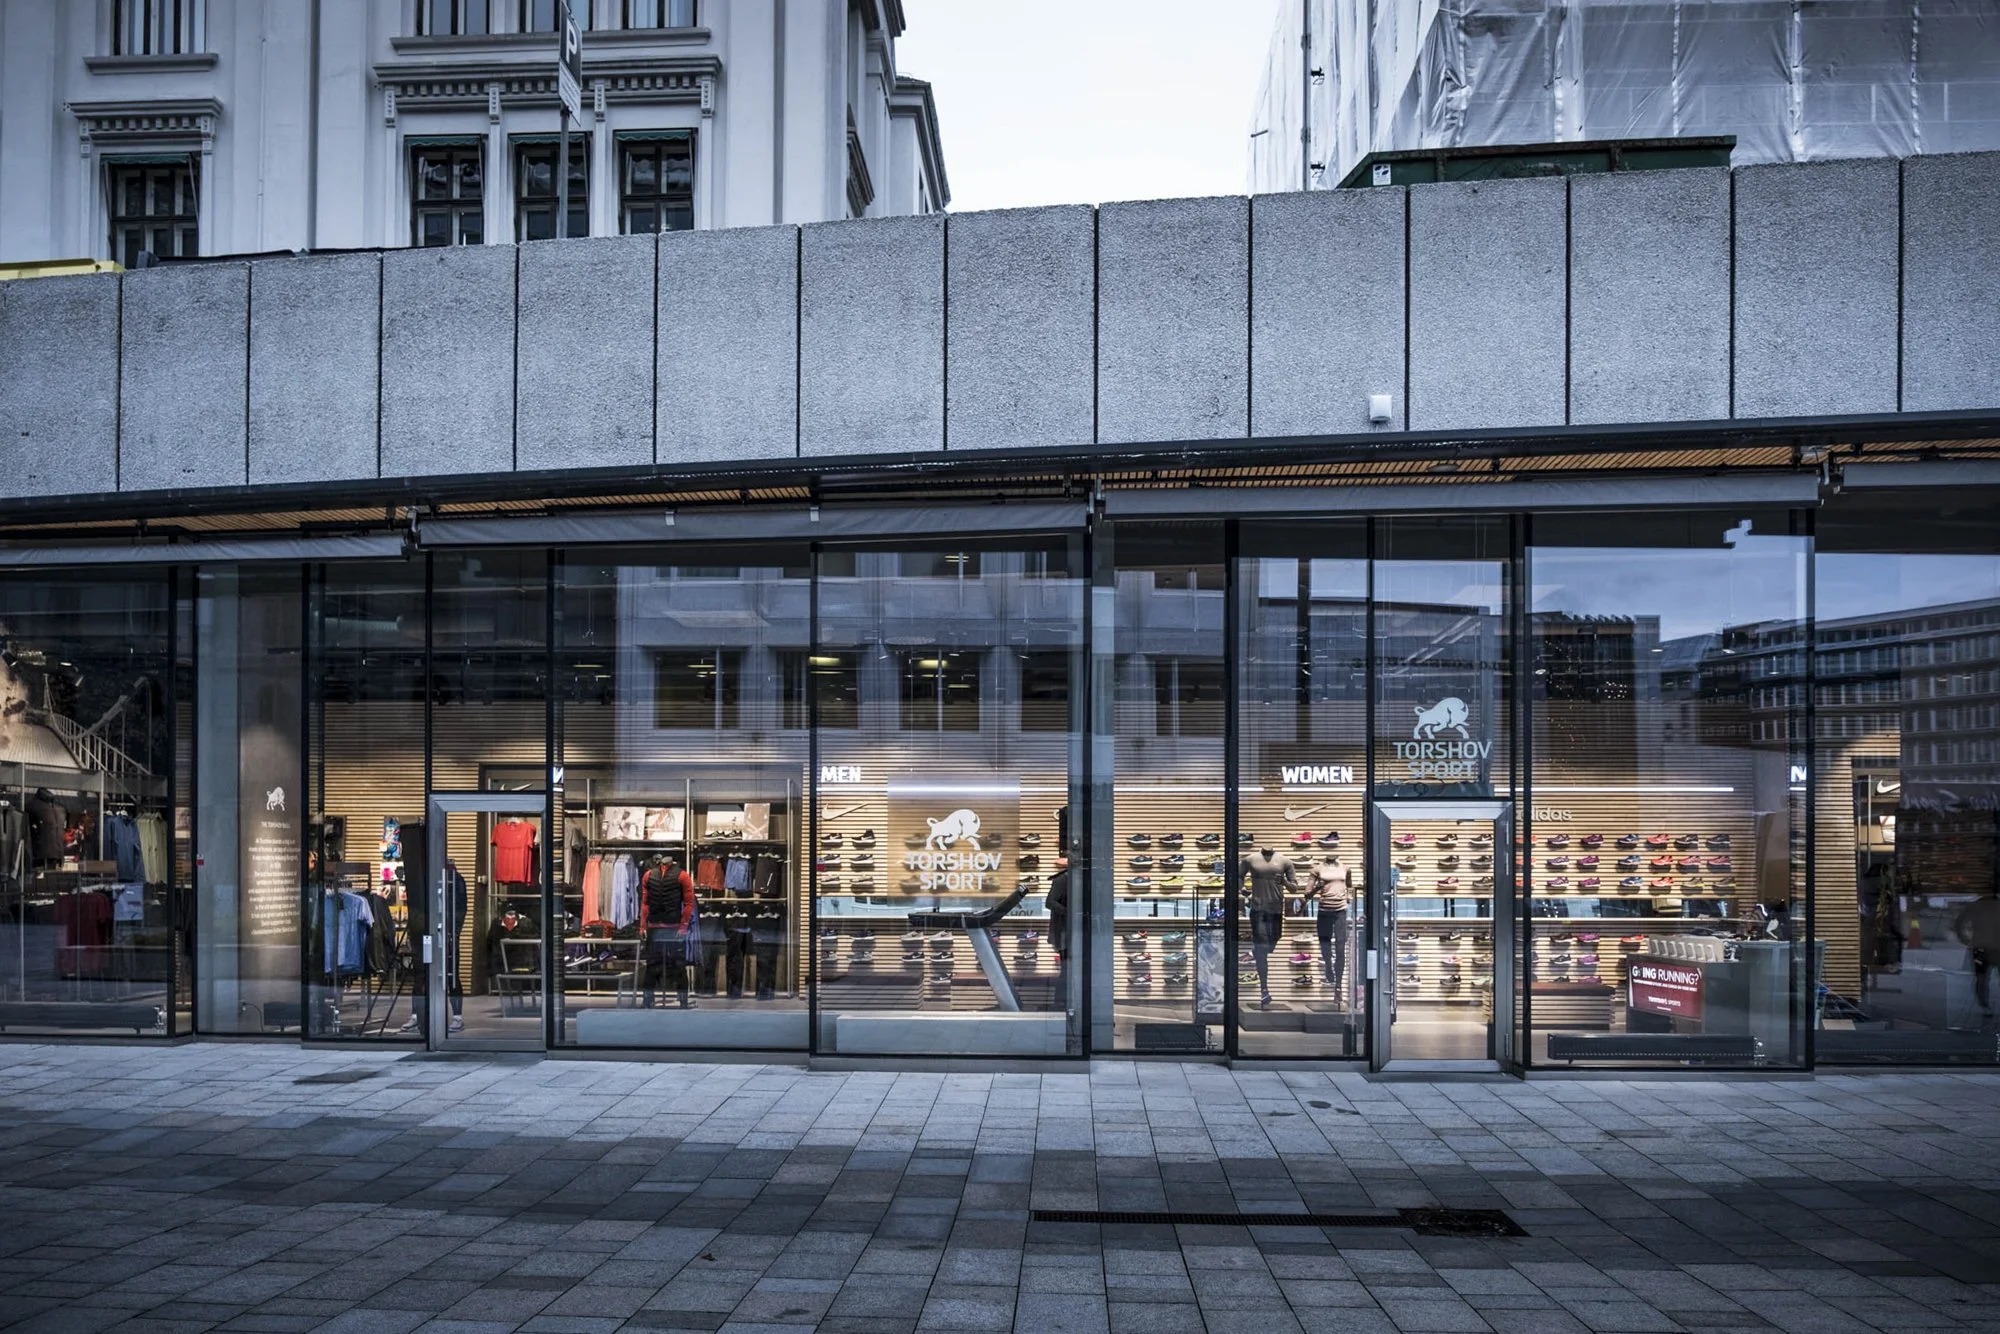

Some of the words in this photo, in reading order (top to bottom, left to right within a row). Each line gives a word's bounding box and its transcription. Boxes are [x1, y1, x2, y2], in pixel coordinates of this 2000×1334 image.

[566, 17, 577, 63] P
[1393, 741, 1492, 759] TORSHOV
[821, 766, 861, 783] MEN
[1281, 766, 1353, 783] WOMEN
[1408, 761, 1476, 778] SPORT
[1516, 806, 1572, 821] aidas
[907, 852, 1001, 871] TORSHOV
[920, 873, 986, 890] SPORT
[1632, 966, 1657, 979] GING
[1658, 969, 1699, 985] RUNNING?
